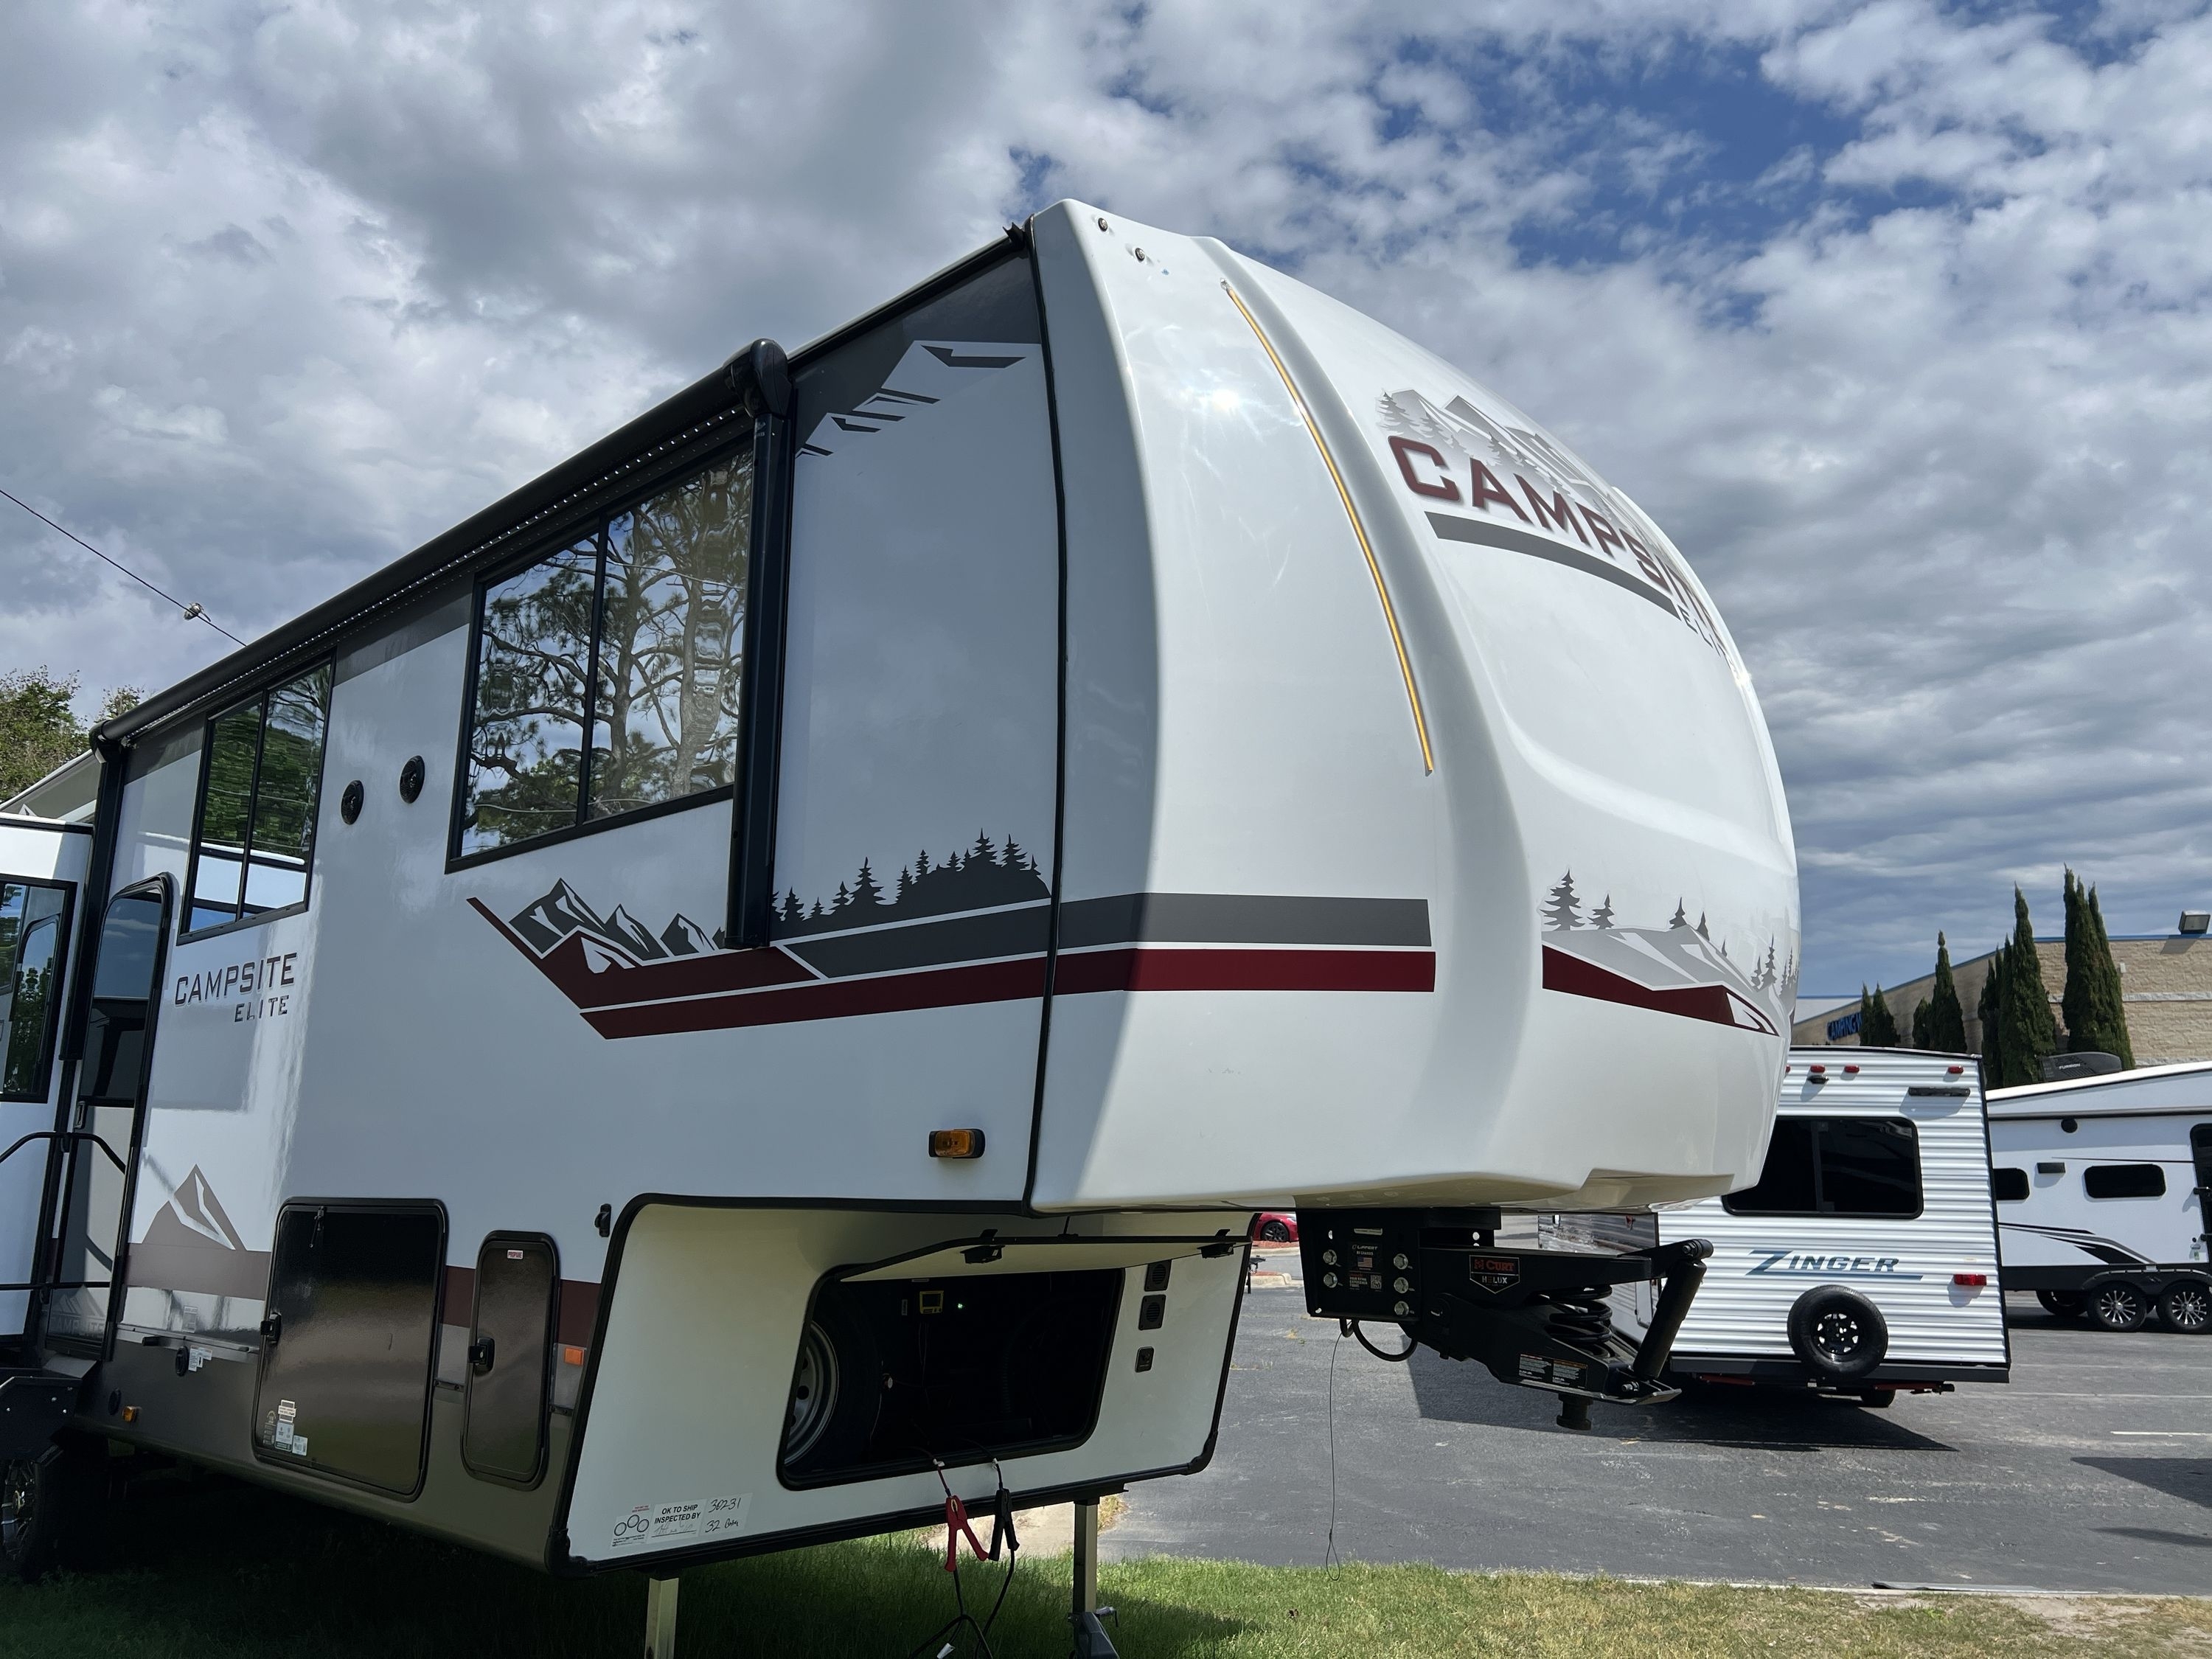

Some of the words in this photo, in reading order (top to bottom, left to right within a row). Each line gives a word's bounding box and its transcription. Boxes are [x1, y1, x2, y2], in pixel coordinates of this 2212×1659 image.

[1388, 435, 1729, 655] CAMPSITE
[175, 953, 297, 1006] CAMPSITE
[234, 995, 290, 1023] ELITE
[1486, 1260, 1514, 1272] CURT
[1745, 1250, 1900, 1276] ZINGER
[1481, 1276, 1508, 1284] HELUX
[683, 1504, 698, 1512] SHIP
[654, 1514, 691, 1524] INSPECTED
[692, 1512, 701, 1520] BY
[705, 1520, 721, 1533] 32
